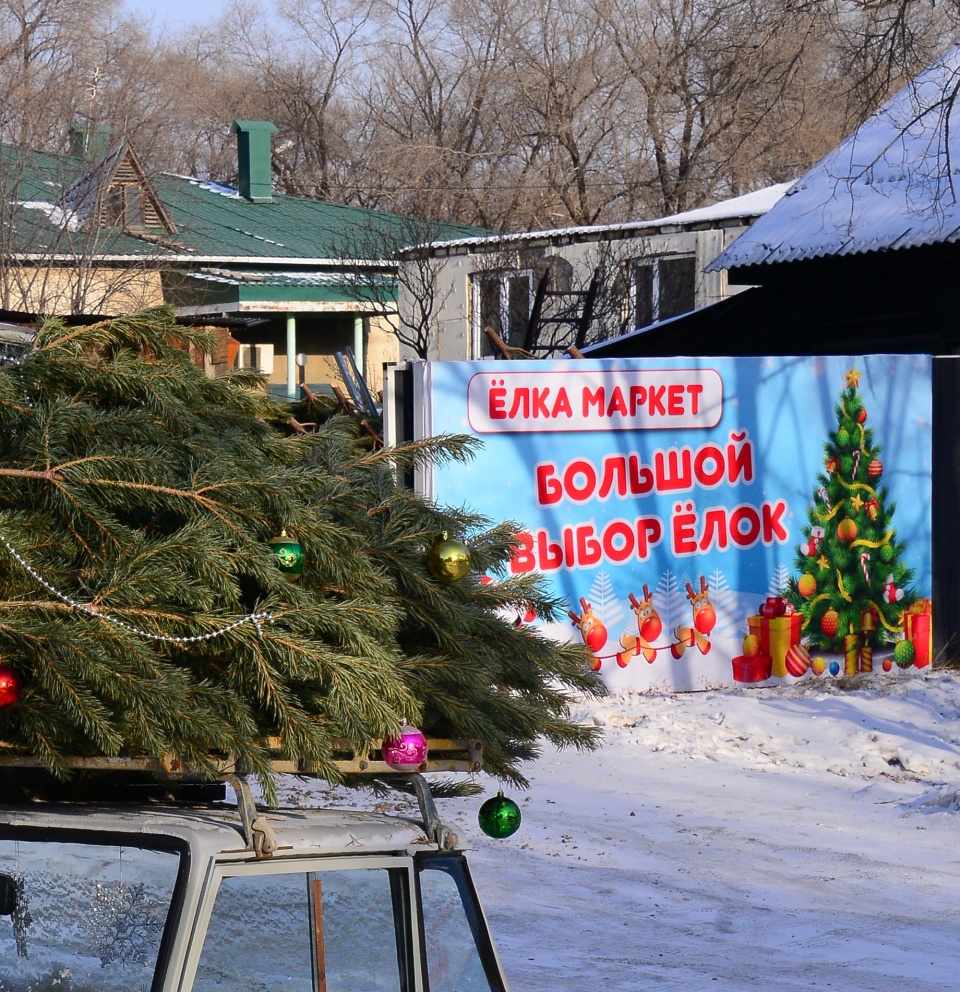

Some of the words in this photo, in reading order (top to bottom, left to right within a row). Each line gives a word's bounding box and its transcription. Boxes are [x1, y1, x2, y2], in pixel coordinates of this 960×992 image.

[489, 379, 573, 419] ЁЛКА
[582, 384, 704, 418] МАРКЕТ
[536, 432, 753, 506] БОЛЬШОЙ
[509, 517, 662, 575] ВЫБОР
[672, 499, 788, 555] ЁЛОК
